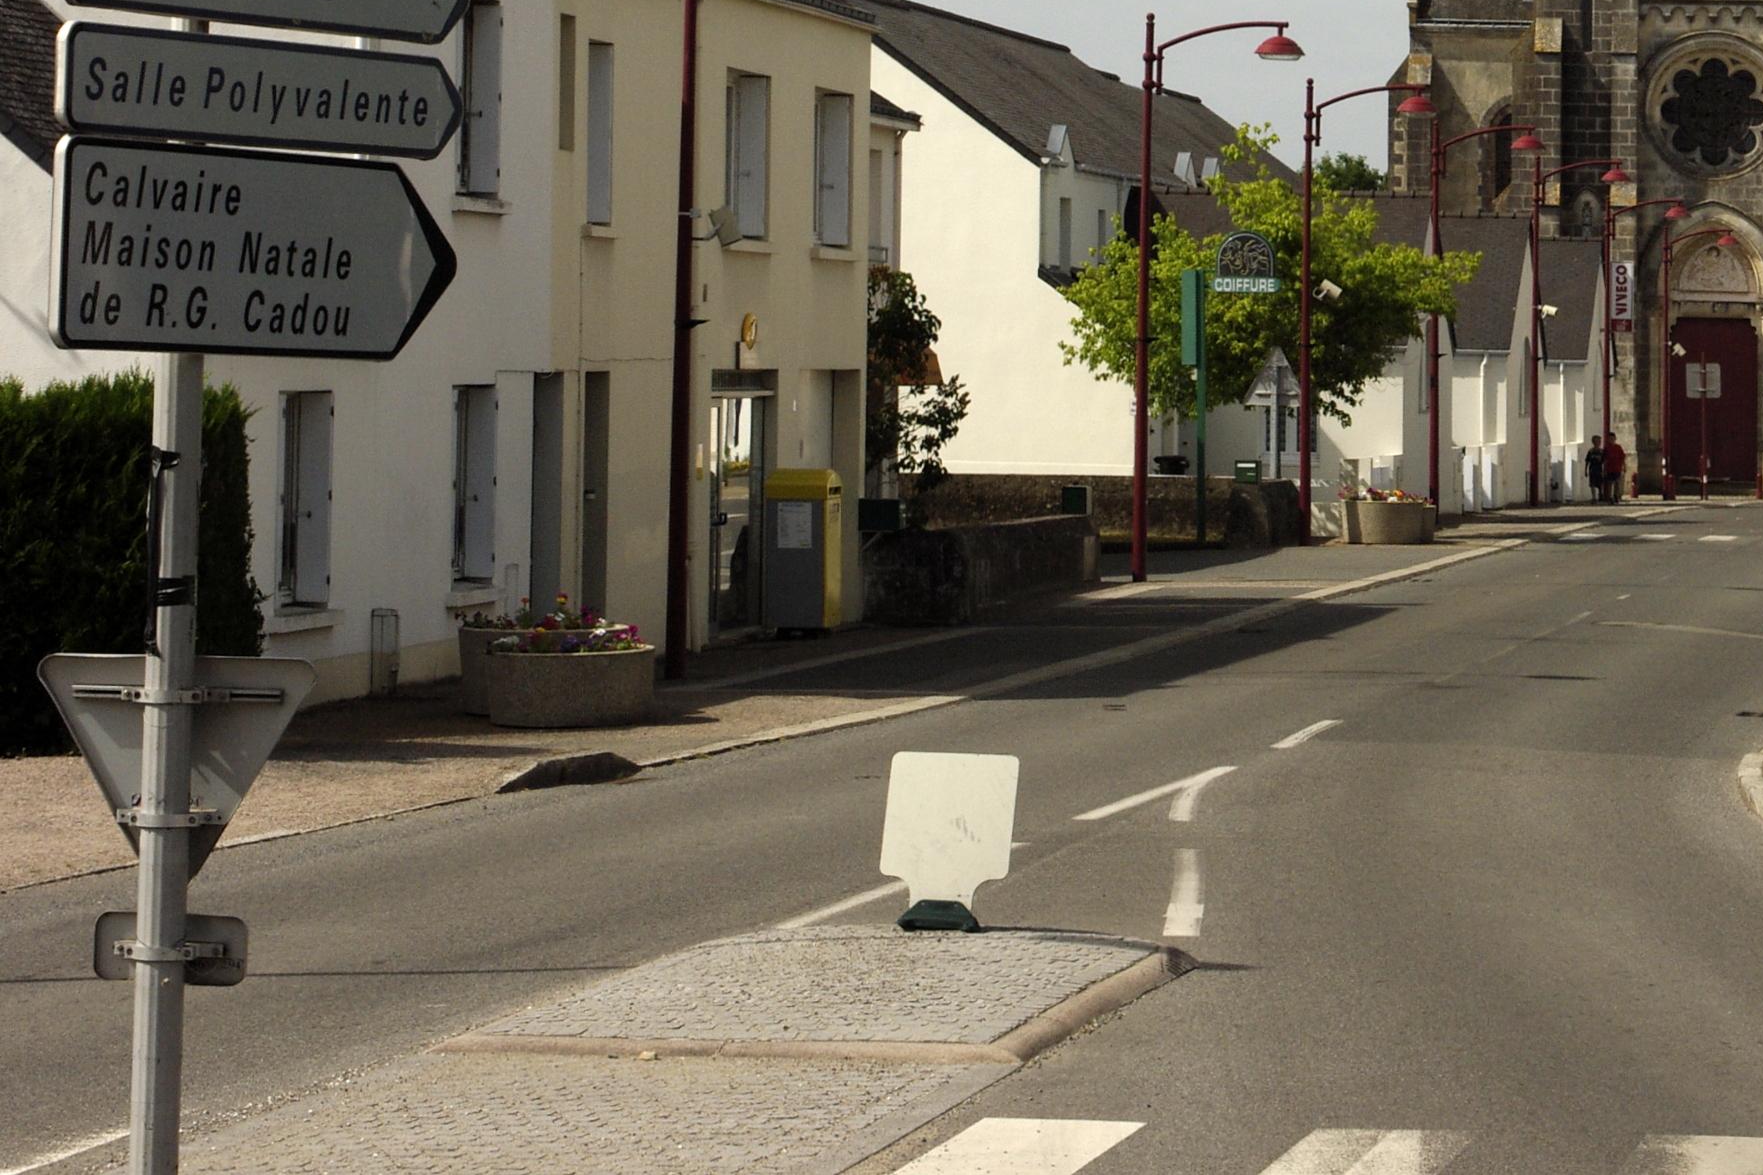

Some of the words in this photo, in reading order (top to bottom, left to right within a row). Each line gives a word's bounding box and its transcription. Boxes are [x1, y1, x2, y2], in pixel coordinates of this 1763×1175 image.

[85, 56, 186, 108] Salle
[203, 66, 429, 127] Polyvalente
[85, 161, 242, 216] Calvaire
[81, 220, 216, 272] Maison
[238, 230, 352, 280] Natale
[79, 281, 122, 326] de
[145, 283, 217, 331] R.G.
[243, 289, 350, 337] Cadou
[1214, 278, 1276, 292] COIFFURE
[1616, 265, 1627, 316] VIVECO
